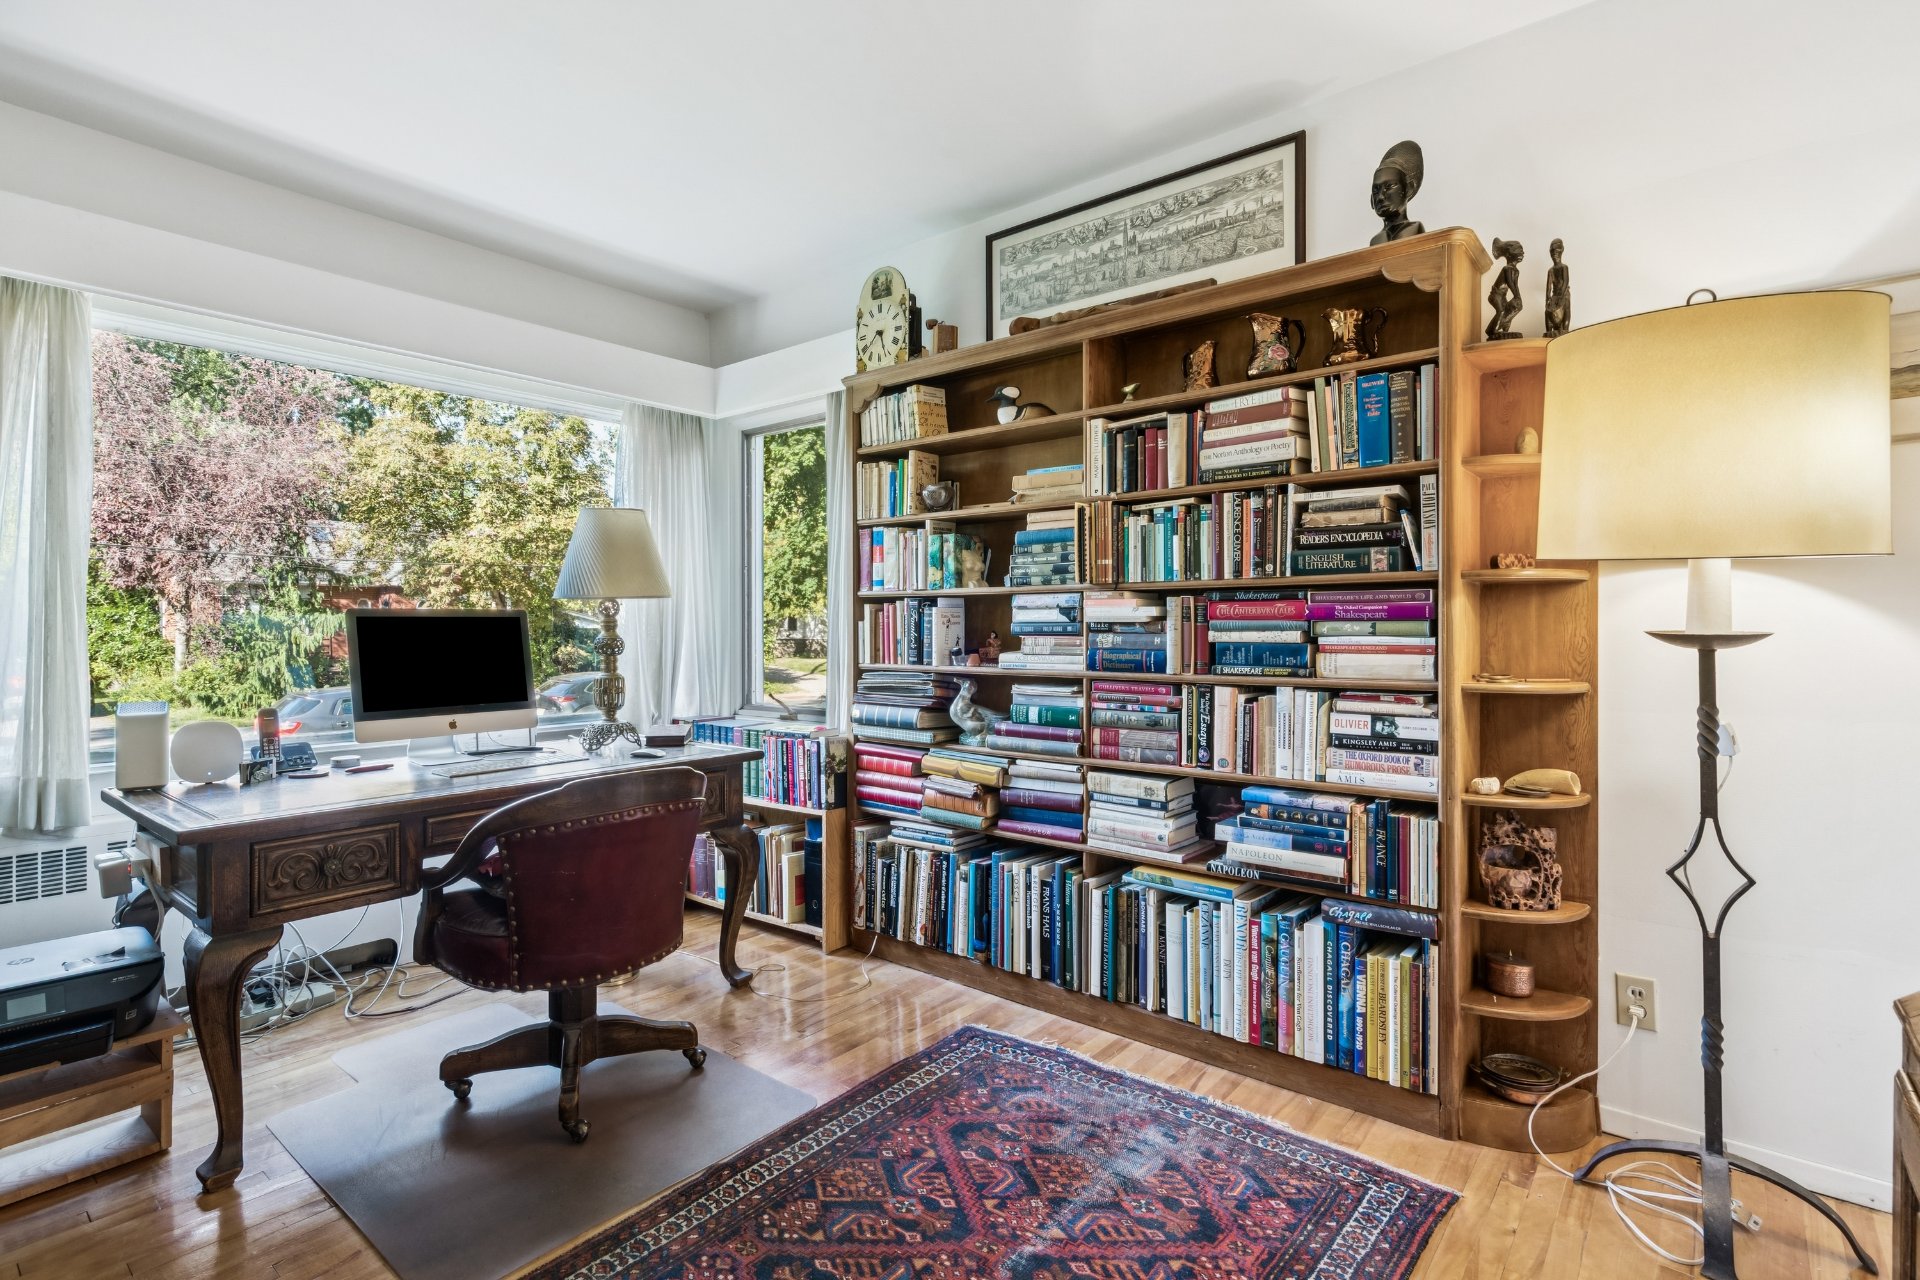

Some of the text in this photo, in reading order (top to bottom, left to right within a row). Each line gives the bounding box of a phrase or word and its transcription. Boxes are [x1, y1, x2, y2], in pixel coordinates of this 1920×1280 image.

[1362, 379, 1384, 388] BREWER
[1212, 450, 1233, 460] Norton
[1233, 445, 1262, 456] Anthology
[1271, 442, 1292, 452] Poetry
[1422, 492, 1436, 530] JOHNSON
[1233, 493, 1242, 562] LAURENCE OLIVIER
[1330, 532, 1384, 542] ENCYCLOPEDIA
[1305, 554, 1344, 563] ENGLISH
[1305, 560, 1357, 570] LITERATURE
[1234, 591, 1280, 600] Shakespeare
[1334, 610, 1388, 620] Shakespeare
[1102, 651, 1142, 660] Biographical
[1103, 661, 1136, 670] Dictionary
[1222, 667, 1263, 675] SHAKESPEARE
[1198, 714, 1210, 746] Essays
[1334, 718, 1368, 730] OLIVIER
[1345, 751, 1412, 765] THE OXFORD BOOK OF
[1345, 760, 1410, 775] HUMOROUS PROSE
[1337, 775, 1365, 784] AMIS
[1231, 847, 1283, 862] NAPOLEON
[1376, 829, 1386, 868] FRANCE
[1210, 863, 1260, 880] NAPOLEON
[1329, 906, 1373, 924] Chagall
[1201, 903, 1209, 950] CEZANNE
[1236, 905, 1248, 952] RENOIR
[1280, 932, 1289, 987] GAUGUIN
[1251, 964, 1259, 980] Gogh
[1265, 945, 1274, 1008] Camille Pissarro
[1357, 974, 1366, 1013] VIENNA
